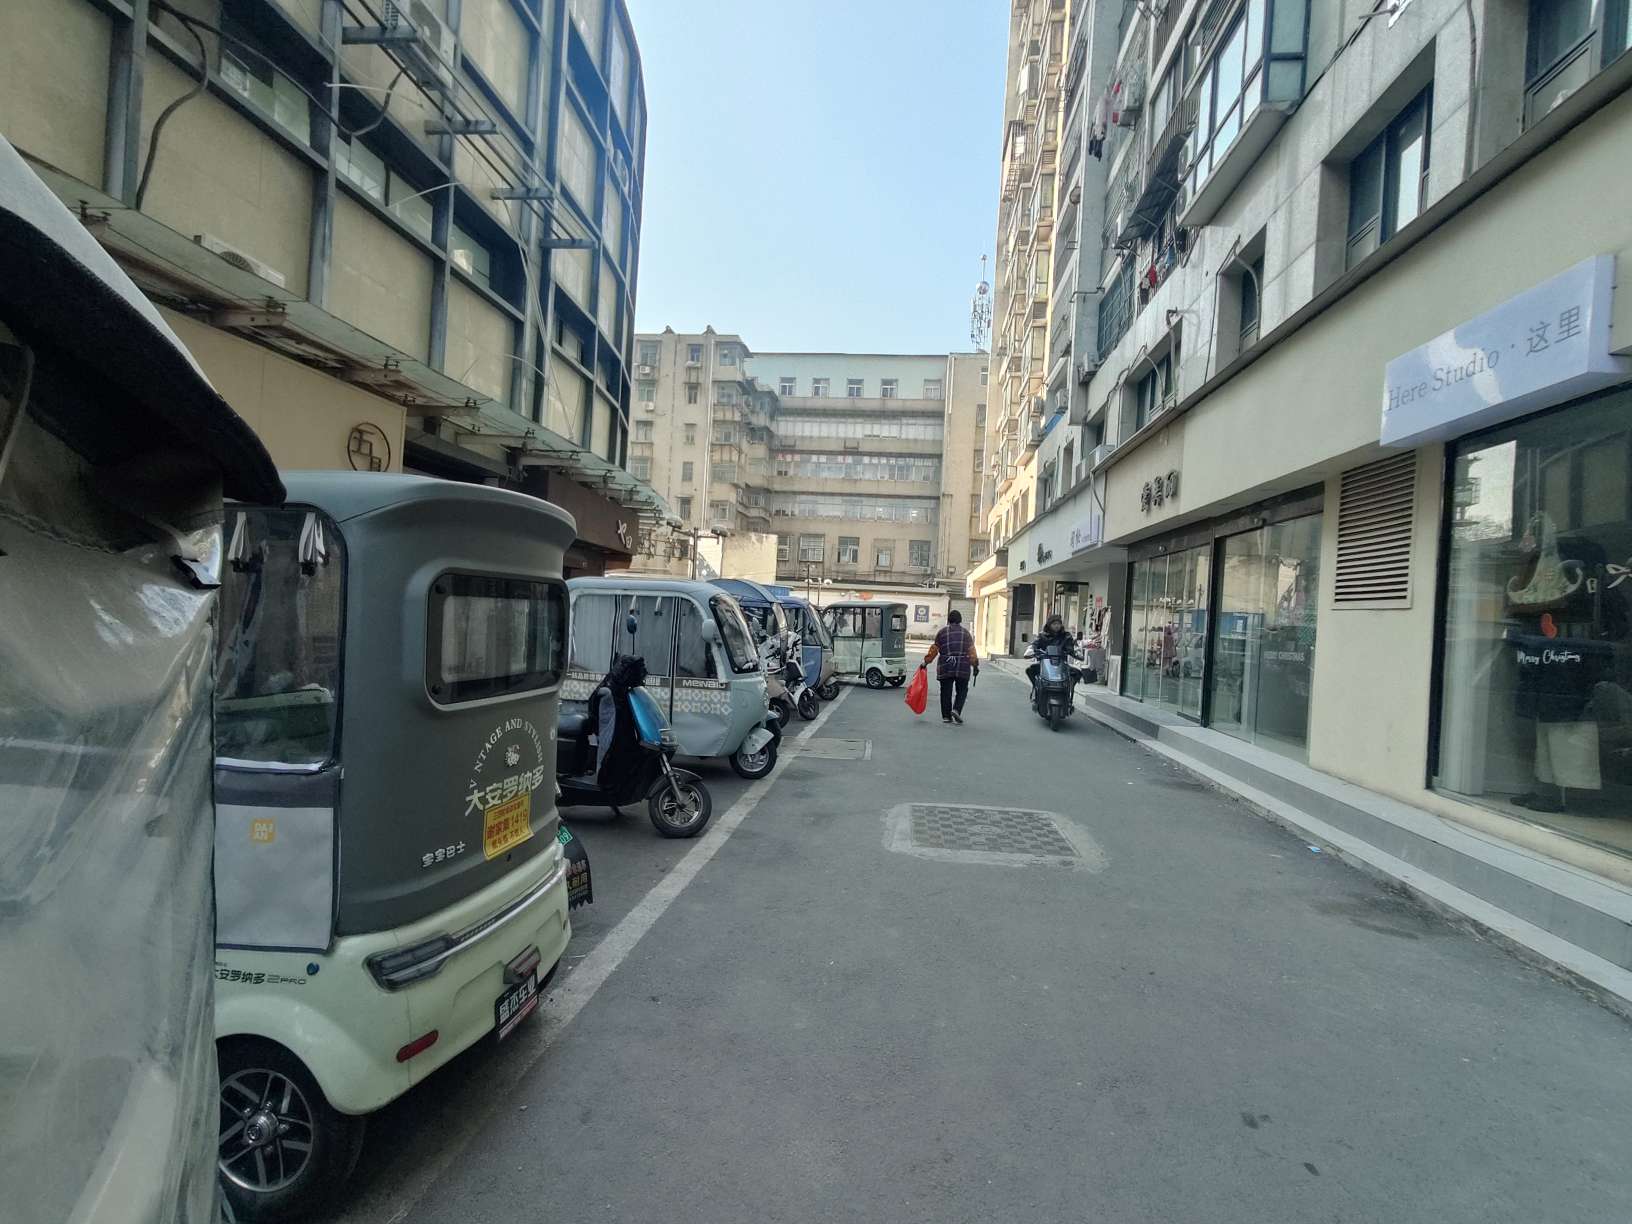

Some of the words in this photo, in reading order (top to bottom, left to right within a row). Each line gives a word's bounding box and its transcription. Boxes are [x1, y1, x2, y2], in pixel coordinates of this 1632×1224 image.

[1526, 305, 1582, 356] 这里
[1388, 384, 1428, 411] Here
[1432, 348, 1499, 391] Studio
[469, 726, 503, 789] VNTAGE
[505, 718, 523, 733] AND
[464, 765, 545, 816] 大安罗纳多
